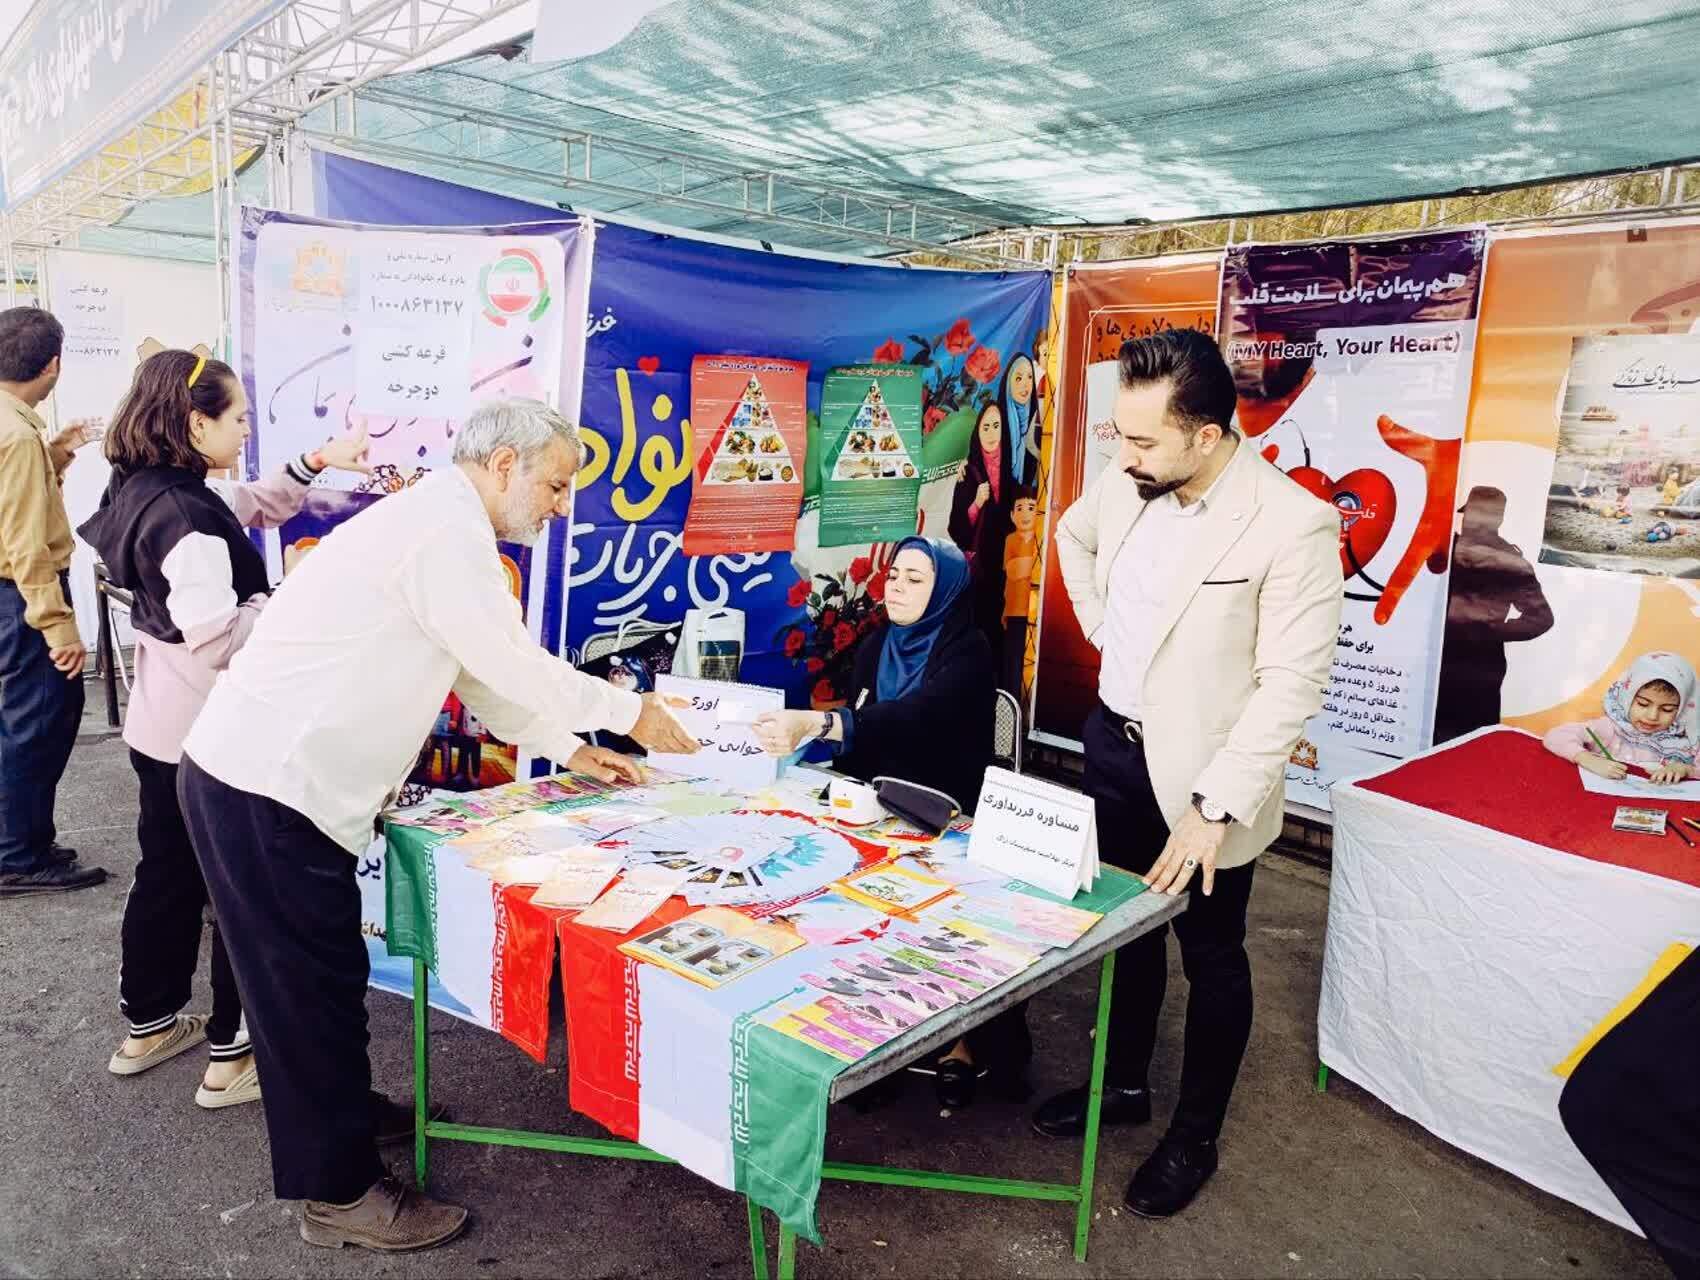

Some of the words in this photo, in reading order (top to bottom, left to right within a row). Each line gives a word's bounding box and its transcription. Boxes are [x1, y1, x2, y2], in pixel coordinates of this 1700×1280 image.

[1270, 282, 1337, 304] سلامت
[1338, 279, 1375, 304] برای
[1270, 339, 1328, 360] Heart,
[1335, 337, 1384, 356] Your
[1390, 330, 1461, 354] Heart)
[1355, 641, 1375, 654] برای
